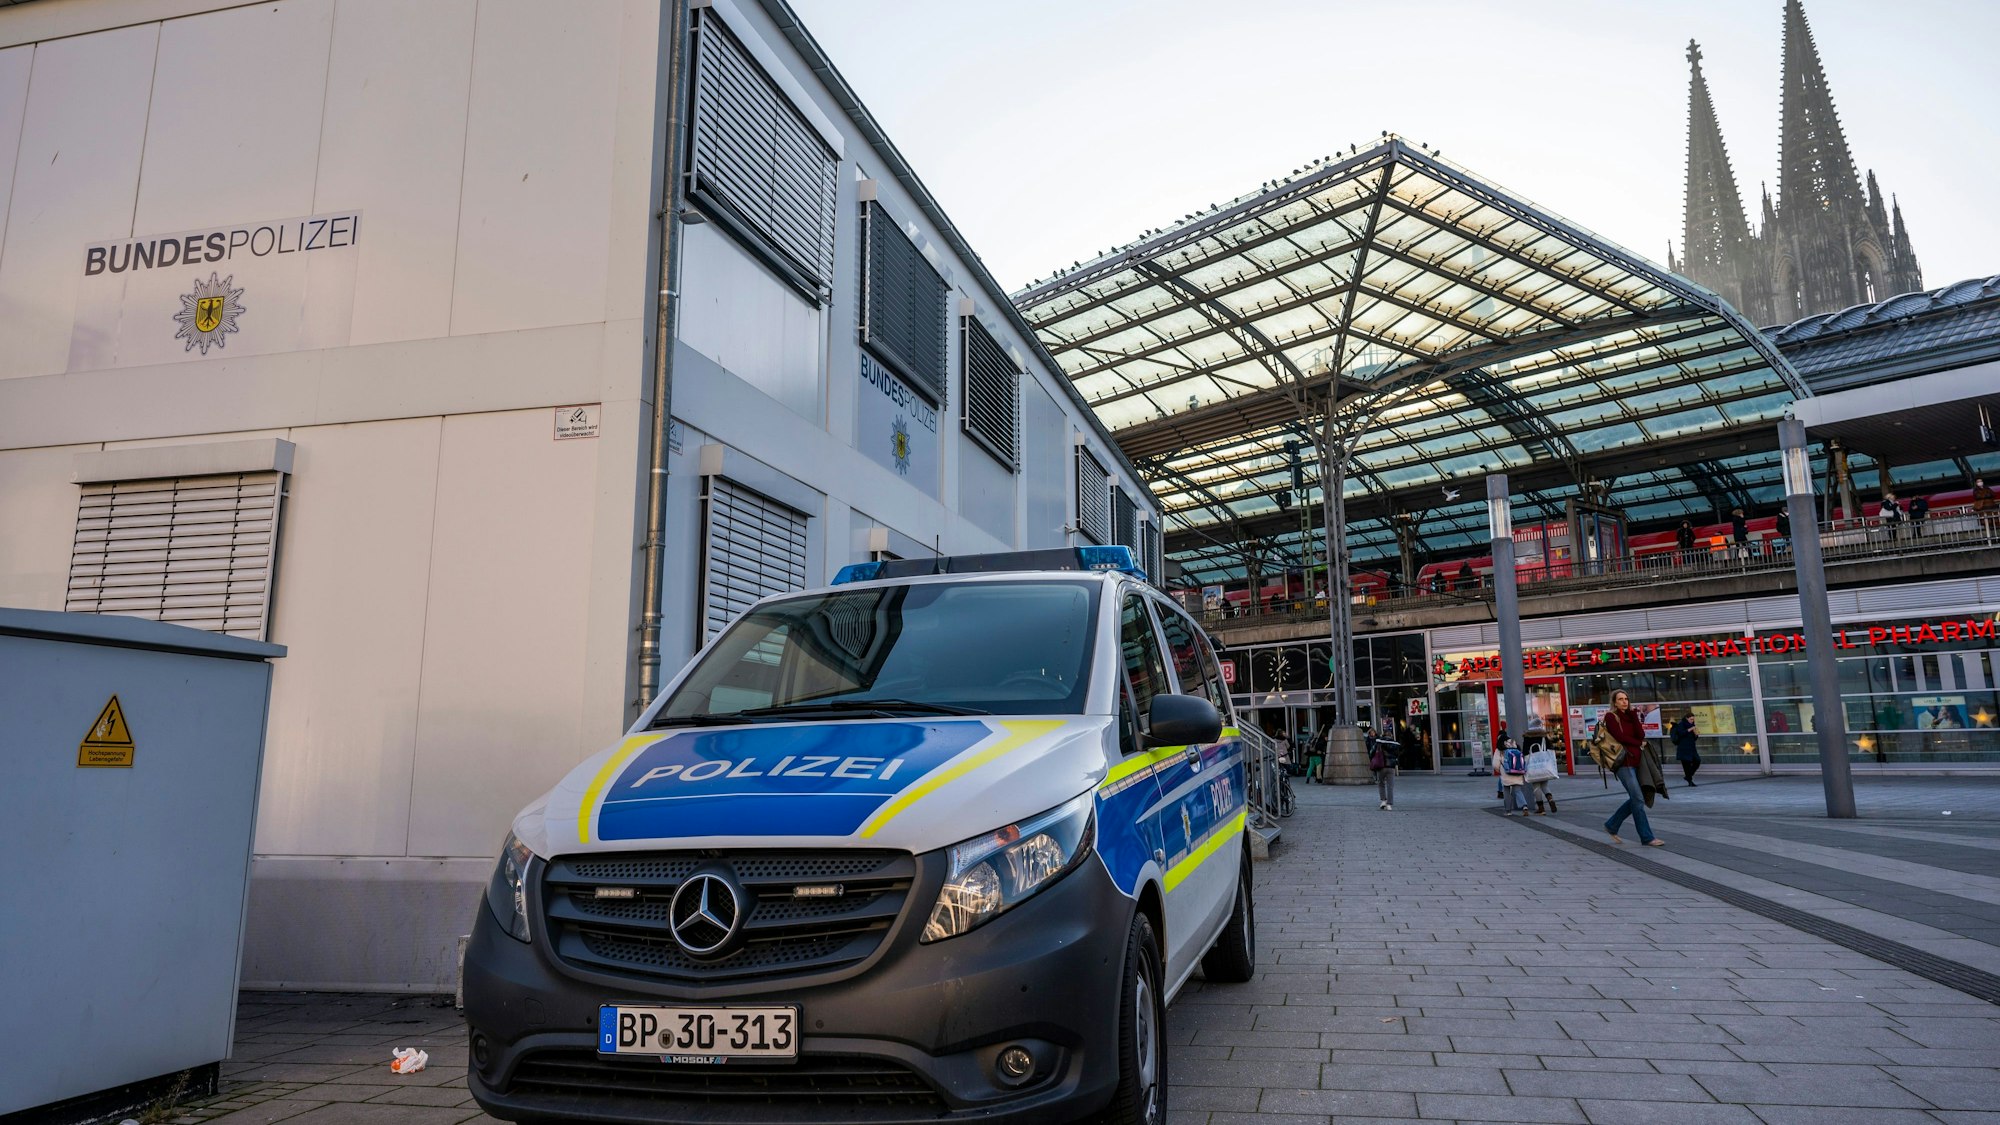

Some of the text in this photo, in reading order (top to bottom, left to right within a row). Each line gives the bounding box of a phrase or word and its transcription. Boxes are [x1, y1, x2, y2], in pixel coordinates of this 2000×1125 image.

[85, 215, 358, 276] BUNDESPOLIZEI
[861, 353, 937, 435] BUNDESPOLIZEI
[1459, 649, 1579, 673] APOHEKE
[1618, 629, 1856, 664] INTERNATIONL
[1869, 618, 1996, 647] PHARM
[630, 755, 905, 788] POLIZEI
[605, 1033, 613, 1044] D
[619, 1013, 792, 1049] BP 30-313
[672, 1056, 716, 1064] MOSOLF
